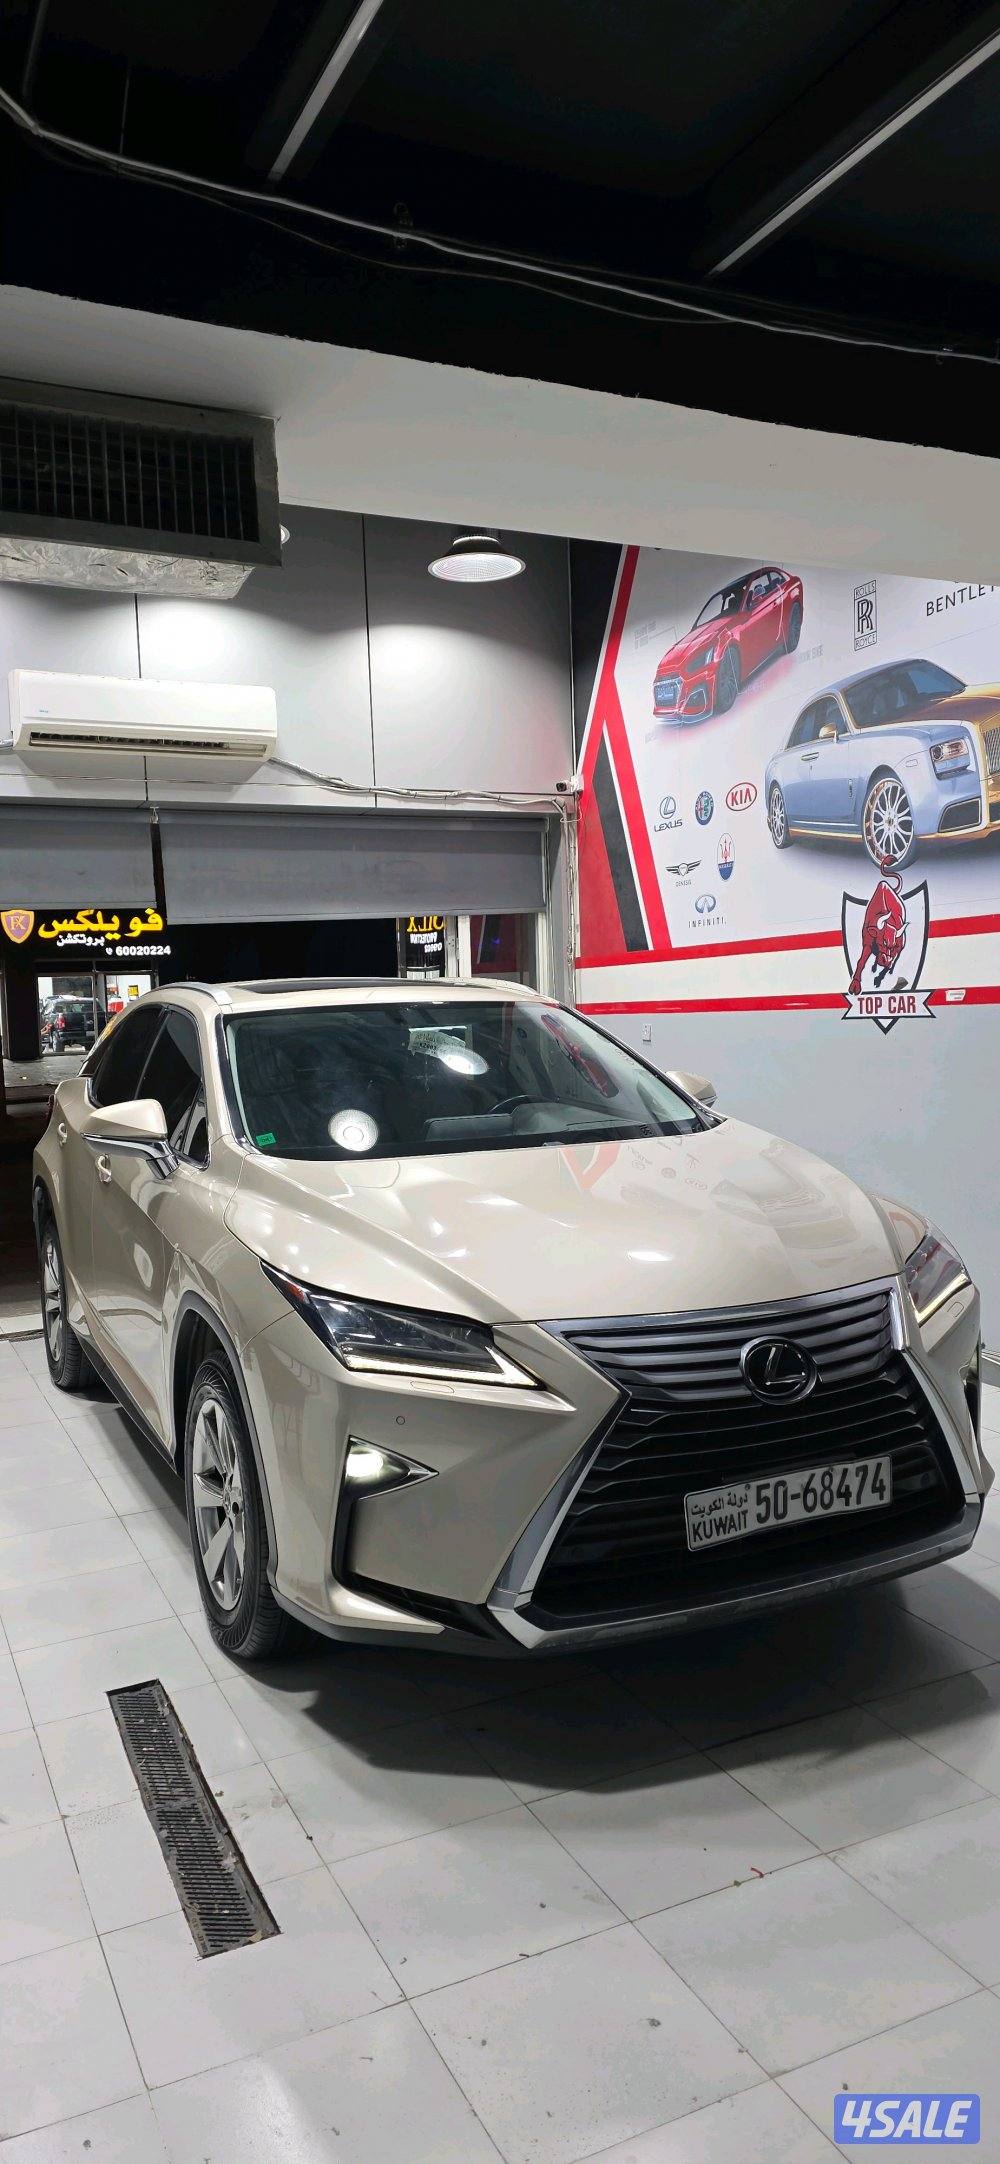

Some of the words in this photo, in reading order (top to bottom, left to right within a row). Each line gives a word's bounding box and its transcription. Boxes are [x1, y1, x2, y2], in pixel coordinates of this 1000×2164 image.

[855, 583, 876, 599] ROLLS
[855, 634, 876, 648] ROYCE
[730, 787, 752, 807] KIA
[653, 818, 683, 833] LEXUS
[115, 945, 171, 956] 60020224
[857, 995, 883, 1015] TOP
[887, 995, 917, 1014] CAR
[727, 1491, 749, 1508] دولة
[755, 1462, 887, 1525] 50-68474
[691, 1499, 725, 1518] الكويت
[692, 1510, 749, 1543] KUWAIT
